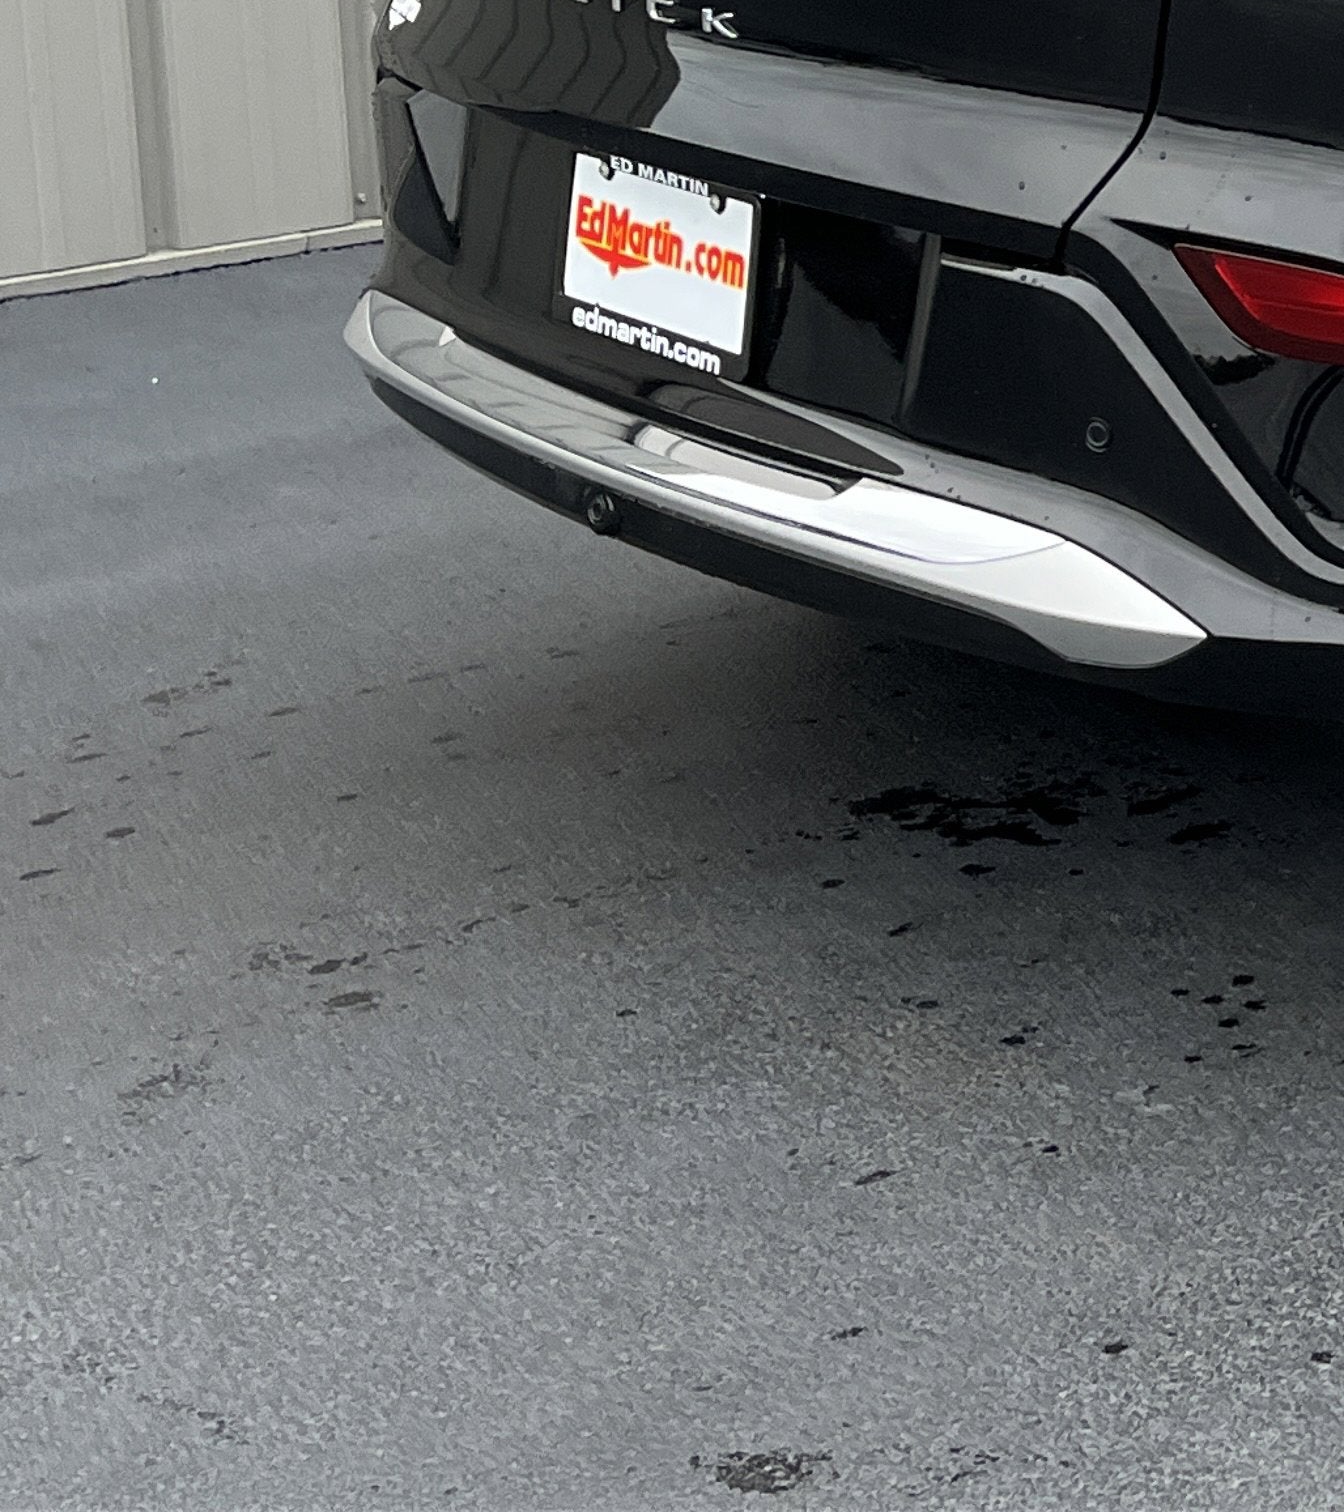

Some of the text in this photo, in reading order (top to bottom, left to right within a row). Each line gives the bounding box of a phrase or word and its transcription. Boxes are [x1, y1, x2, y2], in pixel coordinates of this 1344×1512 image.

[609, 155, 710, 198] ED MARTIN
[575, 194, 746, 290] EdMartin.com
[571, 304, 722, 376] edmartin.com
